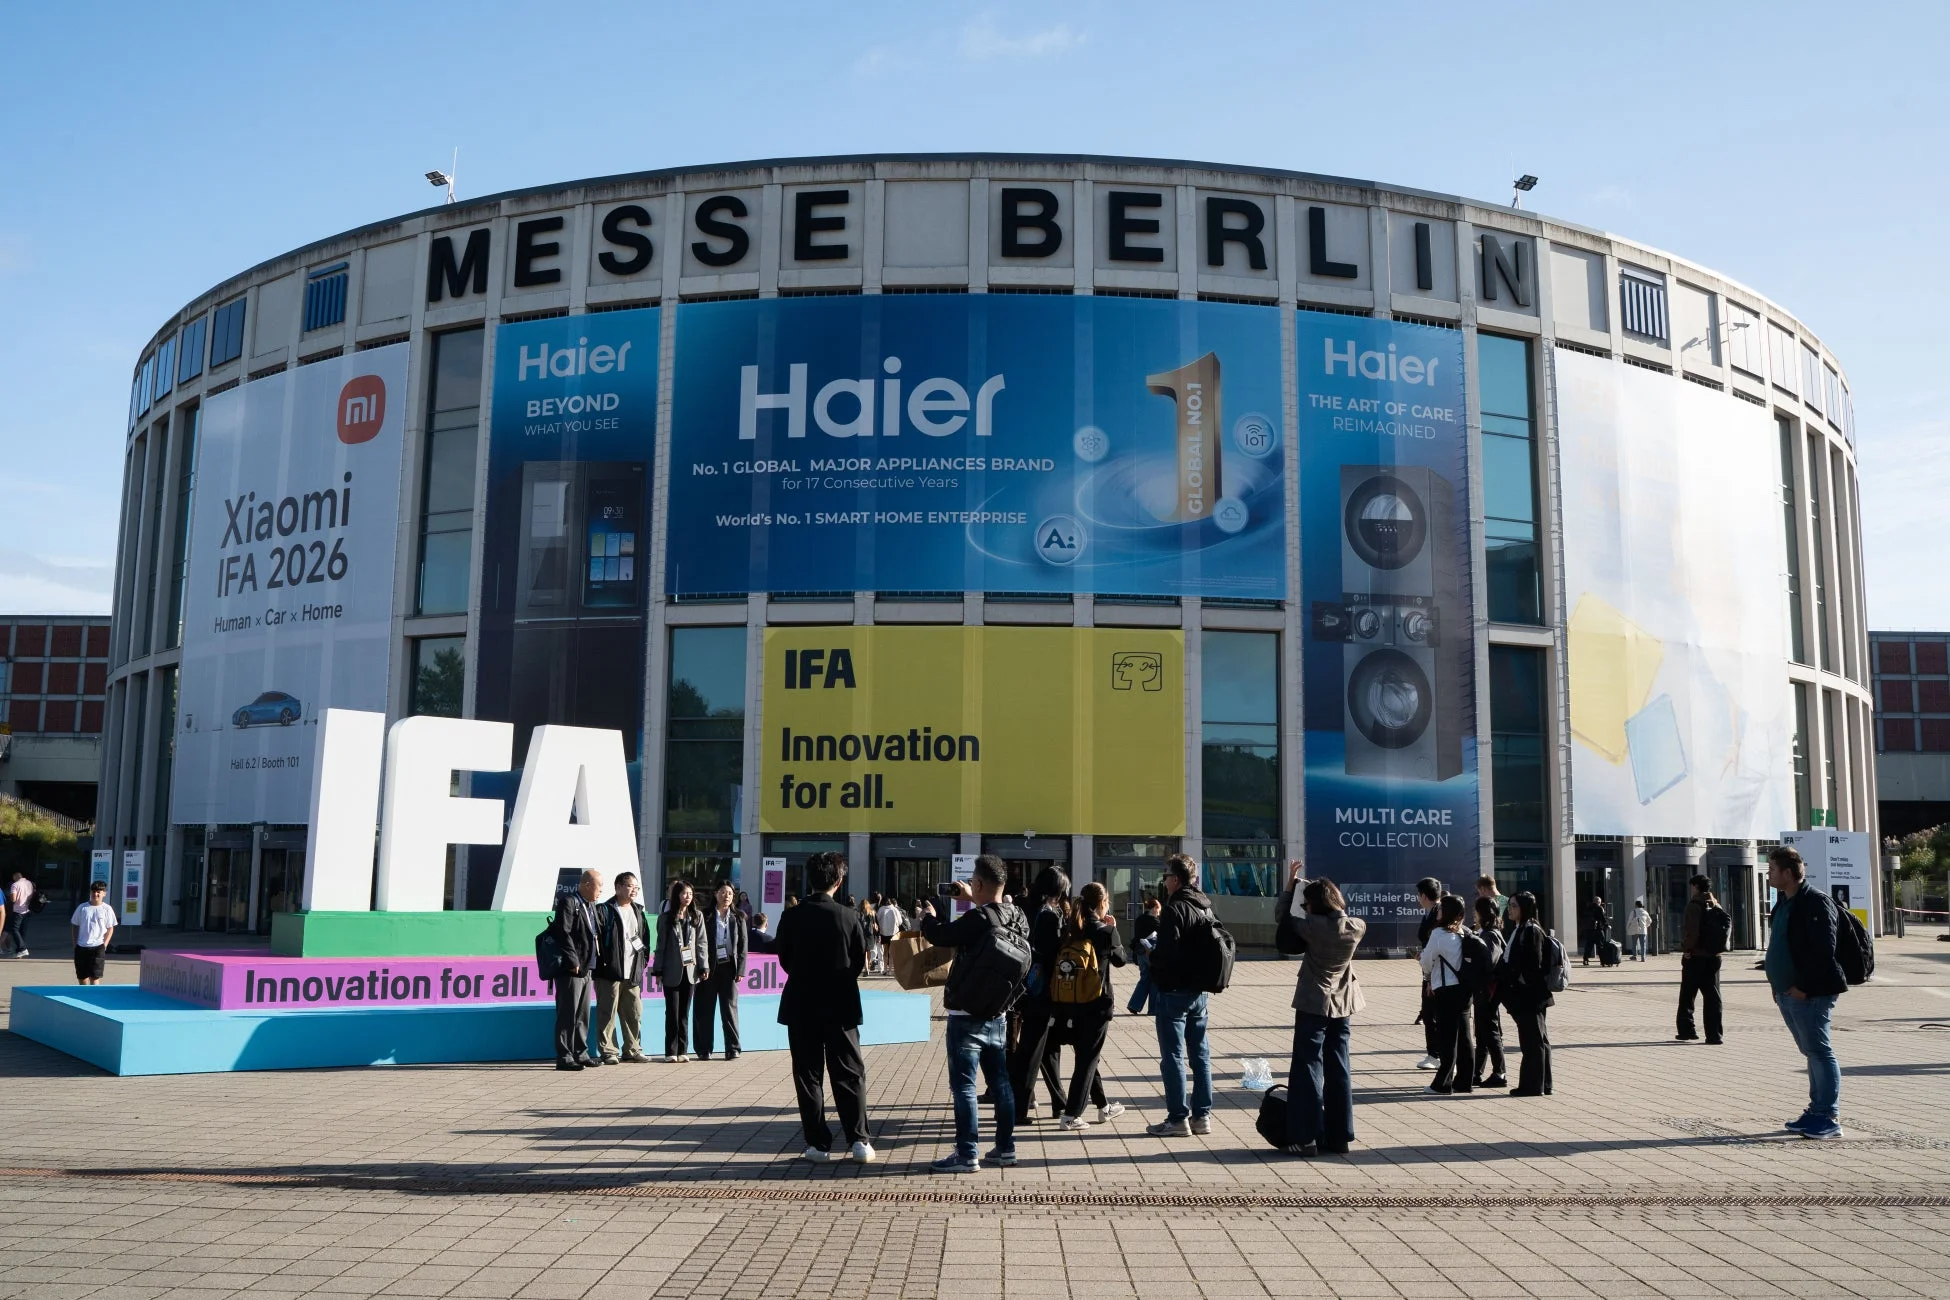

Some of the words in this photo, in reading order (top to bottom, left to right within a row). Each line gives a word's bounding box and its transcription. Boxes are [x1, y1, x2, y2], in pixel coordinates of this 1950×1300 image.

[429, 189, 850, 302] MESSE
[1001, 188, 1530, 306] BERLIN
[519, 337, 631, 381] Haier
[1325, 338, 1439, 386] Haier
[527, 393, 619, 417] BEYOND
[739, 356, 1005, 439] Haier
[1187, 382, 1202, 426] NO.1
[1308, 394, 1342, 410] THE
[1347, 398, 1381, 413] ART
[1385, 402, 1407, 416] OF
[1411, 405, 1457, 425] CARE,
[524, 422, 562, 436] WHAT
[564, 420, 591, 433] YOU
[595, 417, 619, 430] SEE
[1245, 434, 1268, 447] IoT
[1334, 416, 1436, 439] REIMAGINED
[693, 463, 718, 475] No.
[722, 462, 728, 474] 1
[733, 460, 801, 473] GLOBAL
[810, 458, 871, 471] MAJOR
[875, 458, 986, 470] APPLIANCES
[992, 458, 1054, 471] BRAND
[1187, 432, 1203, 514] GLOBAL
[782, 477, 802, 490] for
[805, 477, 820, 489] 17
[824, 477, 914, 488] Consecutive
[918, 476, 958, 488] Years
[221, 471, 352, 550] Xiaomi
[716, 513, 772, 526] World's
[776, 513, 801, 525] No.
[805, 513, 810, 524] 1
[815, 512, 870, 524] SMART
[874, 512, 923, 523] HOME
[929, 511, 1027, 525] ENTERPRISE
[217, 553, 258, 598] IFA
[267, 538, 348, 590] 2026
[214, 616, 251, 633] Human
[265, 608, 287, 626] Car
[302, 604, 343, 622] Home
[785, 649, 856, 689] IFA
[782, 727, 979, 761] Innovation
[231, 759, 244, 770] Hall
[245, 758, 256, 769] 6.2
[262, 757, 285, 769] Booth
[287, 756, 299, 768] 101
[780, 774, 832, 809] for
[839, 774, 895, 810] all.
[302, 708, 644, 911] IFA
[1336, 808, 1395, 824] MULTI
[1401, 809, 1452, 825] CARE
[1811, 808, 1837, 827] IFA
[1339, 832, 1448, 848] COLLECTION
[1829, 836, 1839, 844] IFA
[1347, 892, 1371, 902] Visit
[1374, 892, 1401, 902] Haier
[1347, 906, 1368, 916] Hall
[1372, 906, 1384, 916] 3.1
[1397, 906, 1426, 915] Stand
[142, 957, 187, 996] Innovation
[188, 966, 202, 997] for
[203, 969, 218, 1002] all.
[246, 969, 430, 1002] Innovation
[440, 968, 484, 998] for
[492, 966, 536, 997] all.
[748, 961, 784, 990] all.
